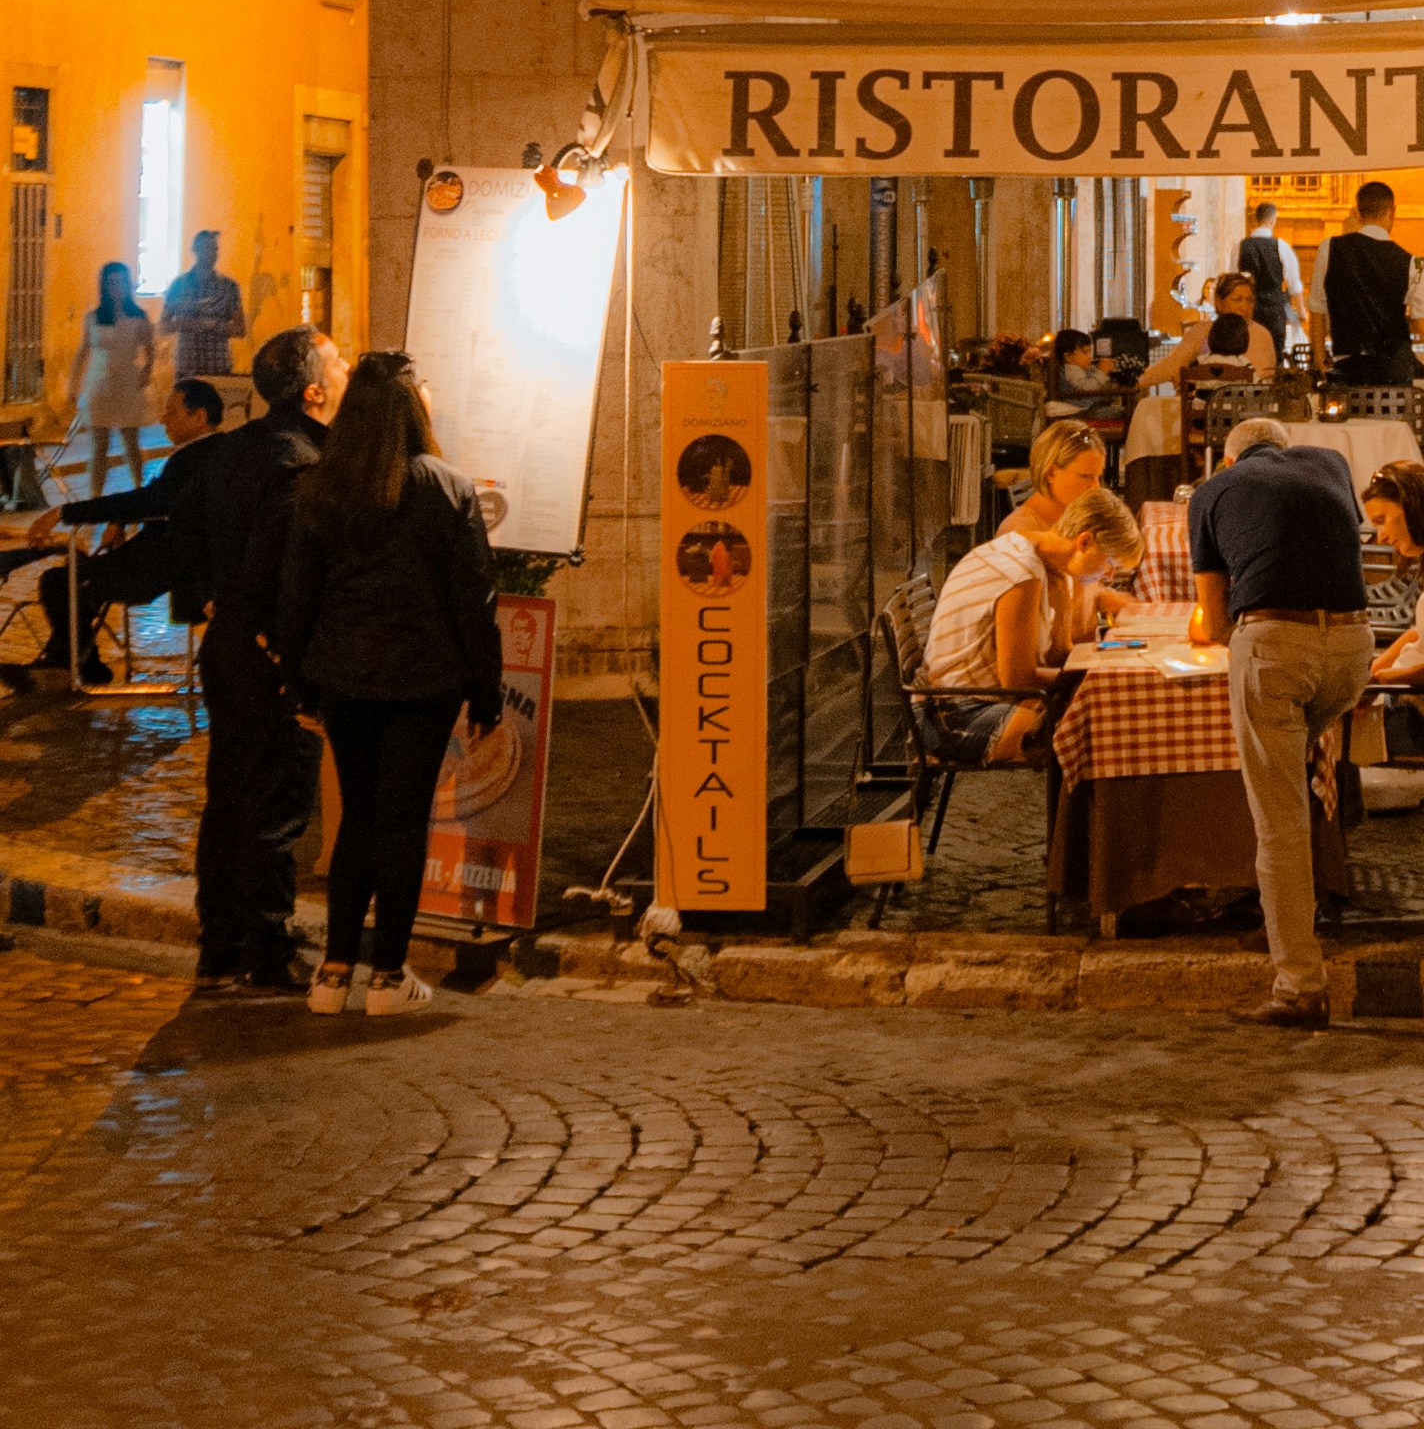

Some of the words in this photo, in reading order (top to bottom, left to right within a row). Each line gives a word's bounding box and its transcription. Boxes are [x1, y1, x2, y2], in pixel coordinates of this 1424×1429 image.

[682, 417, 748, 428] DOMIZIANO
[694, 606, 734, 896] COCKTAILS
[454, 862, 516, 894] PIZZERIA
